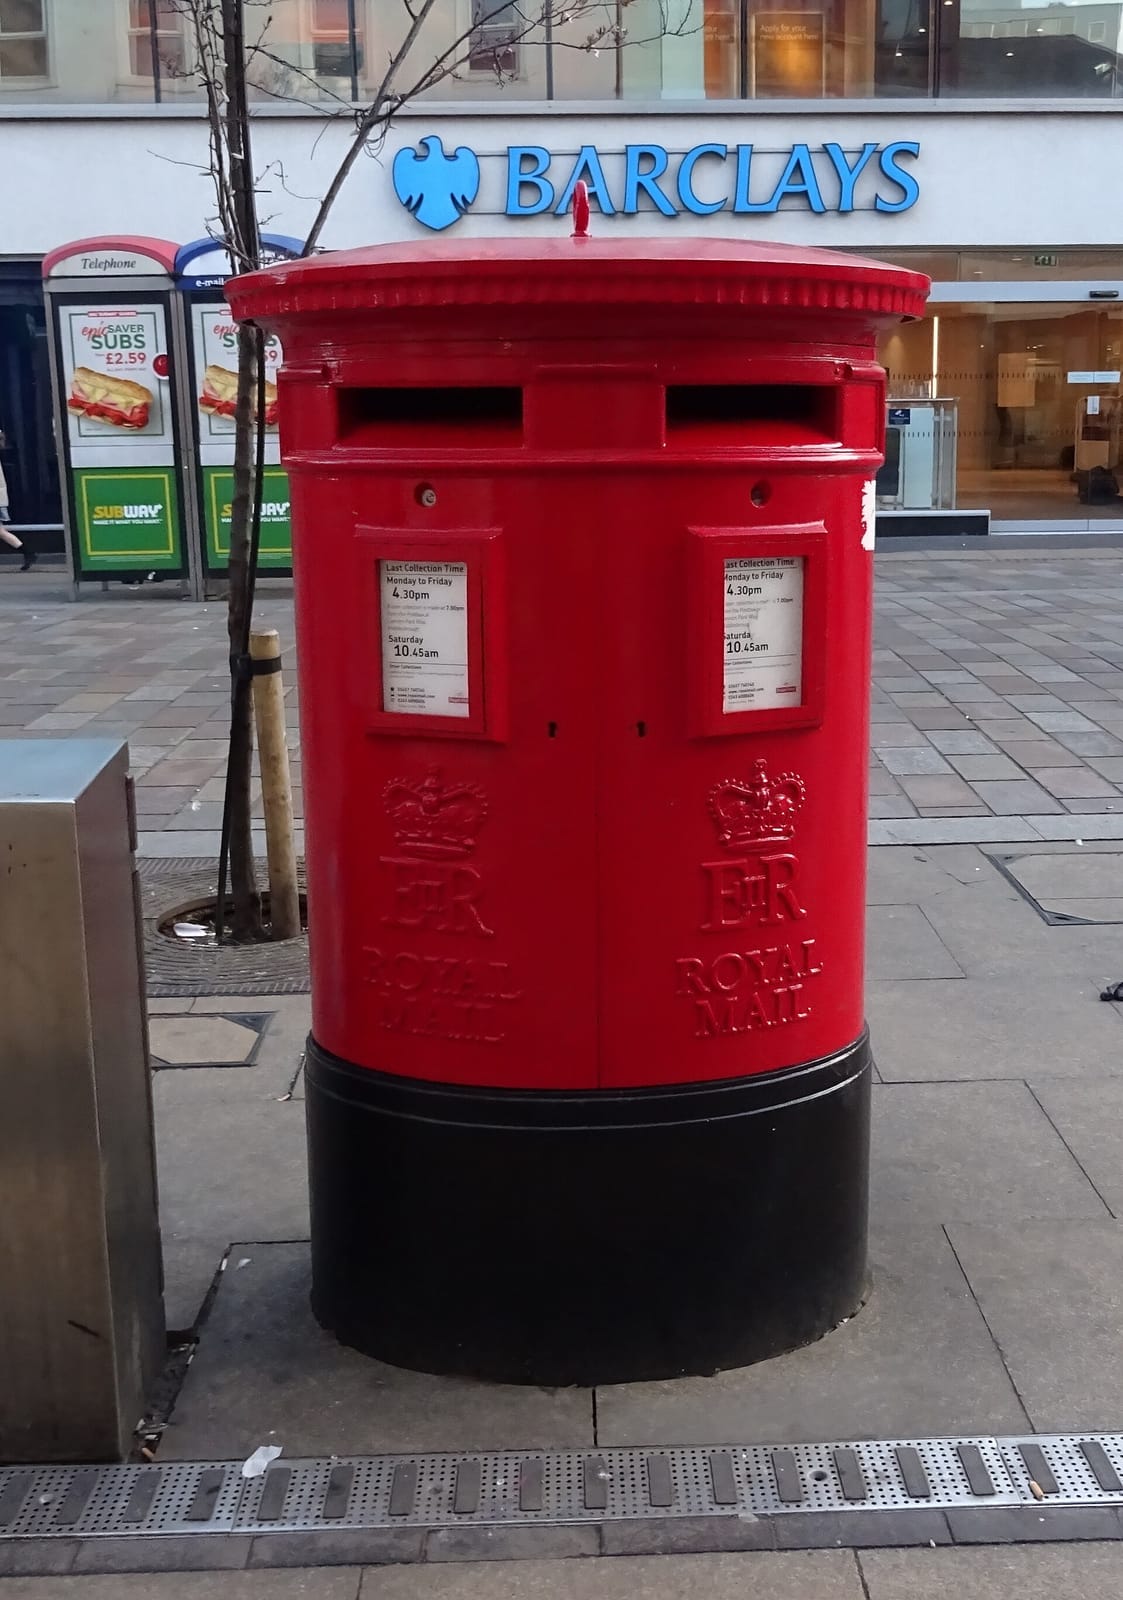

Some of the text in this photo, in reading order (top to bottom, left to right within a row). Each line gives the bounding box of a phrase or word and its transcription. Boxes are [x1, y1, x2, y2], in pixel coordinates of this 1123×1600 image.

[760, 24, 779, 32] Apply
[506, 141, 920, 216] BARCLAYS
[81, 257, 137, 271] Telephone
[81, 321, 145, 341] epic SAVER
[91, 334, 146, 350] SUBS
[106, 352, 147, 365] £2.59
[93, 504, 163, 519] SUBWAY
[386, 564, 403, 572] Last
[404, 564, 442, 573] Collection
[726, 558, 794, 569] ast Collection Time
[386, 576, 416, 586] Monday
[428, 578, 452, 587] Friday
[761, 572, 784, 581] Friday
[392, 586, 430, 601] 4.30pm
[726, 584, 762, 598] 4.30pm
[388, 635, 424, 645] Saturday
[394, 644, 439, 658] 10.45am
[726, 641, 768, 654] 10.45am
[361, 945, 523, 1001] ROYAL
[675, 939, 825, 996] ROYAL
[693, 983, 813, 1037] MAIL
